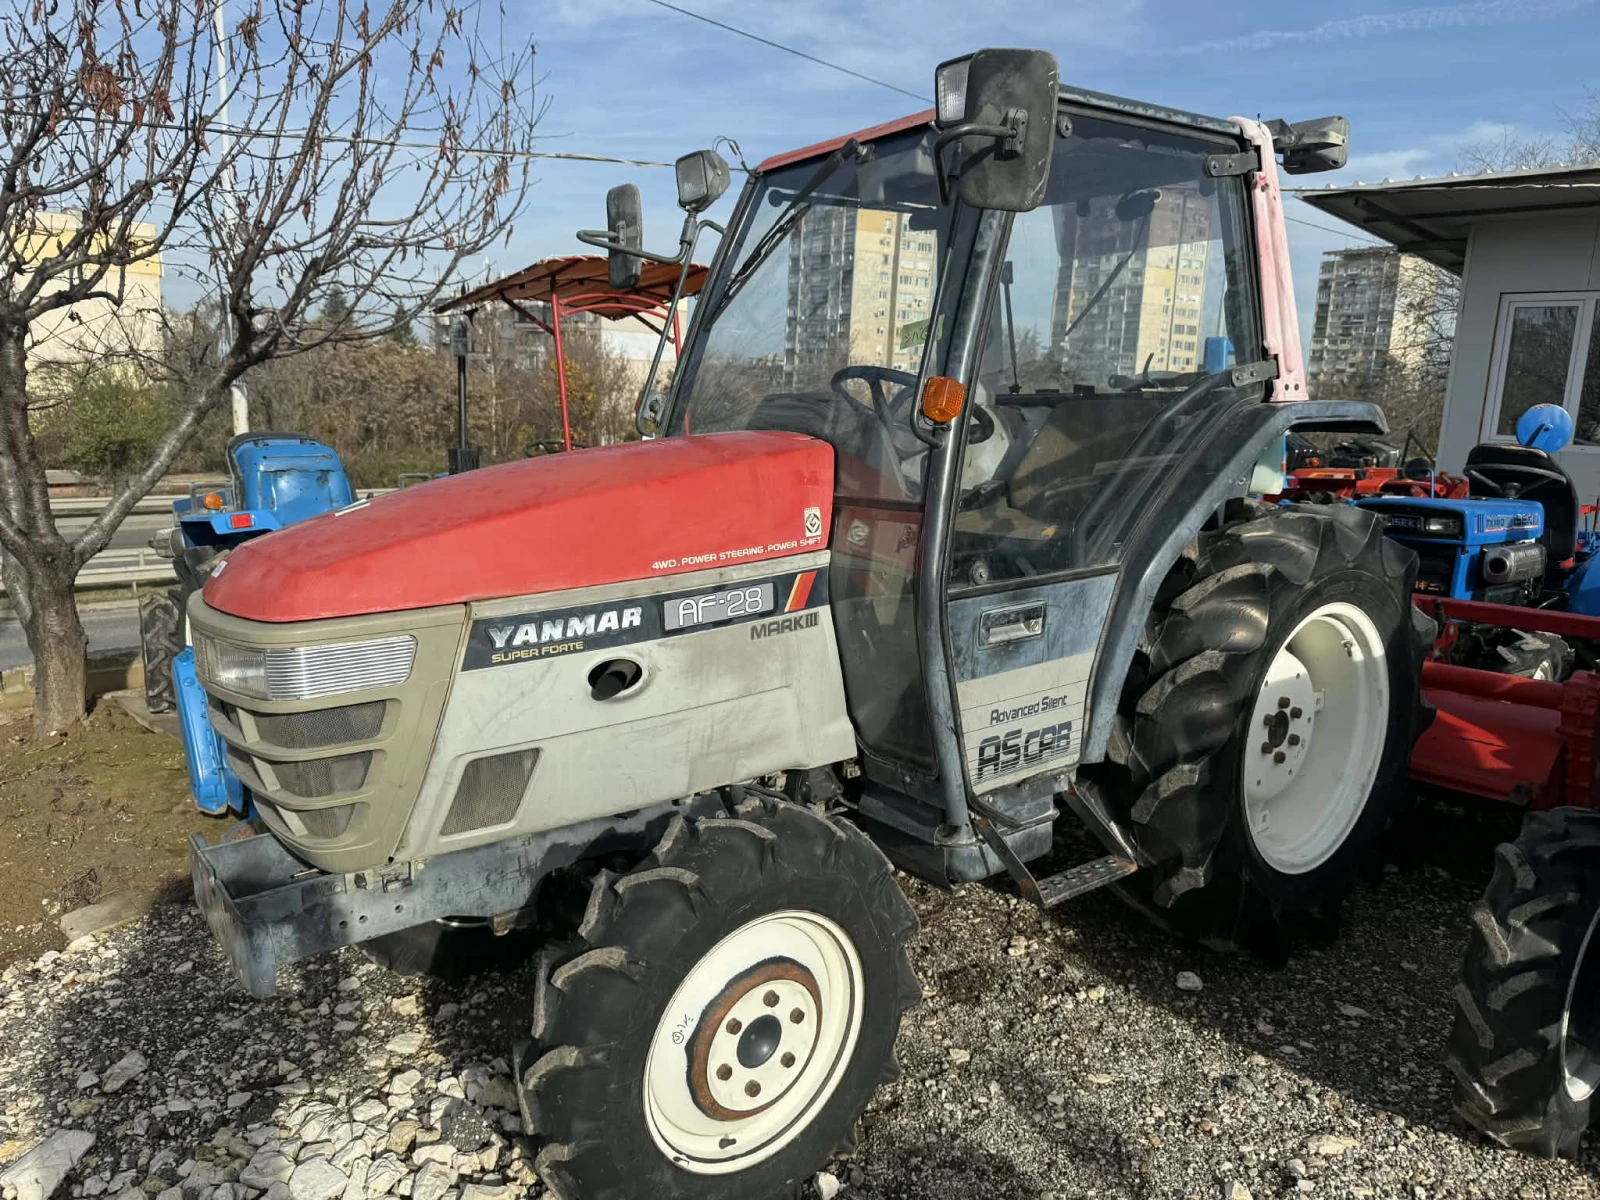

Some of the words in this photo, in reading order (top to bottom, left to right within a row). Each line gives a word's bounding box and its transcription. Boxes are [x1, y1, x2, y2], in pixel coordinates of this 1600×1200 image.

[682, 553, 717, 567] POWER
[799, 536, 822, 547] SHIFT
[488, 606, 642, 649] YANMAR
[491, 649, 539, 664] SUPER
[541, 640, 584, 656] FORTE
[990, 701, 1040, 725] Advanced
[1040, 694, 1068, 712] Silent
